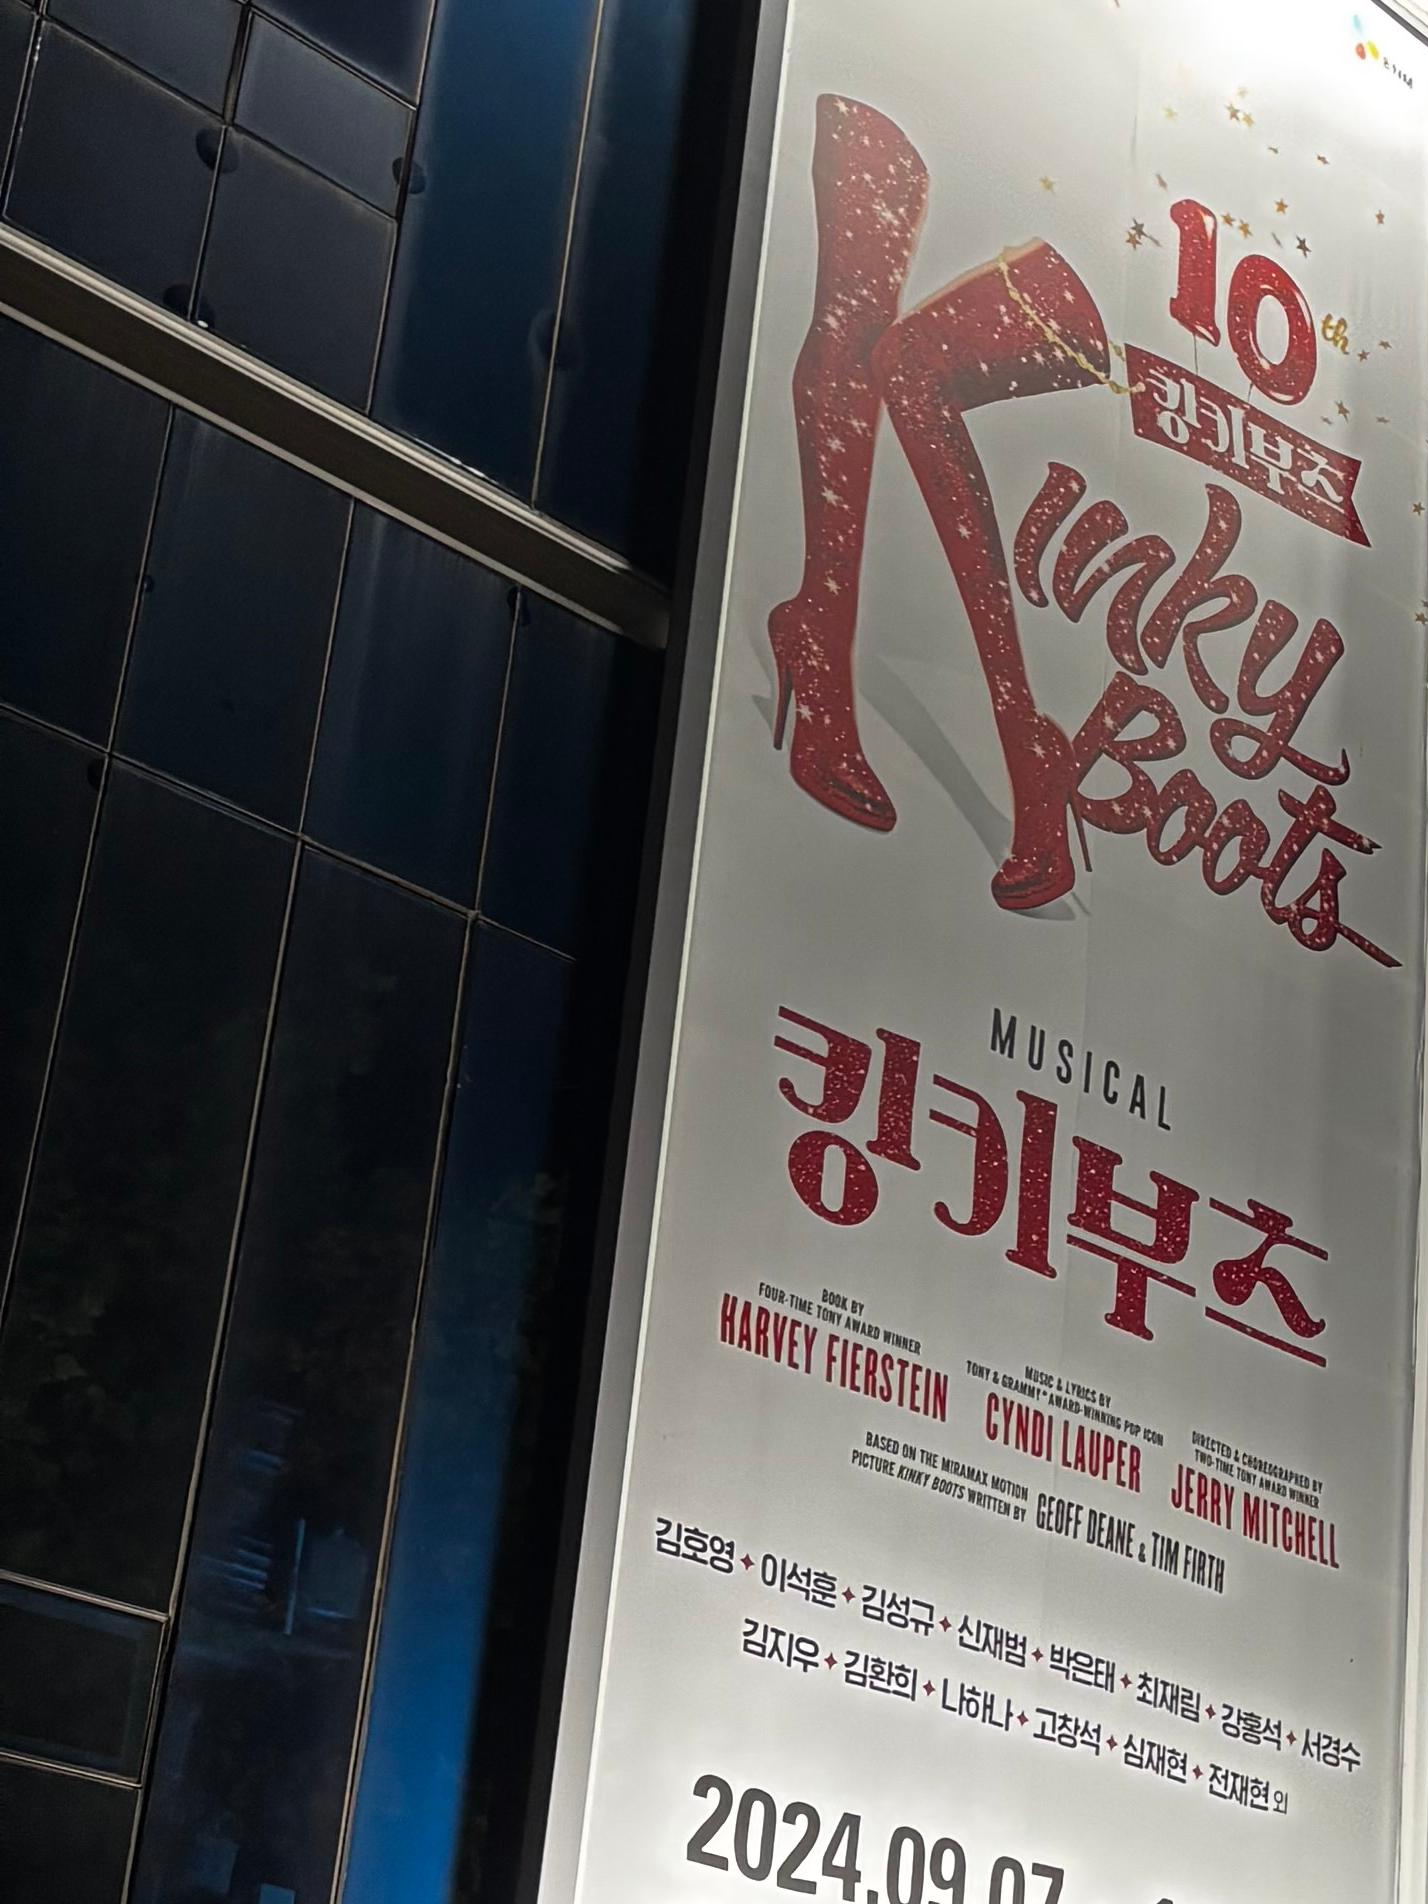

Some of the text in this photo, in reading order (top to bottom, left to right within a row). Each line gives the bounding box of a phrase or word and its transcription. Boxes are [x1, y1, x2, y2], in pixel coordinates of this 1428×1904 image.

[1149, 371, 1346, 512] 킹키부츠
[1071, 671, 1402, 968] Boots
[990, 1008, 1173, 1131] MUSICAL
[774, 1005, 1329, 1368] 킹키부츠
[758, 1281, 922, 1356] FOUR-TIME TONY AWARD WINNER
[821, 1288, 865, 1317] BOOK BY
[720, 1292, 949, 1423] HARVEY FIERSTEIN
[966, 1360, 990, 1379] TONY
[992, 1371, 999, 1384] &
[1124, 1419, 1141, 1438] POP
[1143, 1425, 1164, 1446] ICON
[1024, 1366, 1053, 1389] MUSIC
[1099, 1393, 1112, 1409] BY
[851, 1449, 1027, 1523] PICTURE KINKY BOOTS WRITTEN BY
[865, 1431, 1030, 1503] BASED ON THE MIRAMAX MOTION
[985, 1392, 1142, 1494] CYNDI LAUPER
[1192, 1430, 1323, 1494] DIRECTED & CHOREOGRAPHED BY
[1195, 1449, 1320, 1509] TWO-TIME TONY AWARD WINNER
[1036, 1492, 1226, 1594] GEOFF DEANE & TIM FIRTH
[1171, 1463, 1340, 1569] JERRY MITCHELL
[654, 1517, 1362, 1774] 김호영 이석훈 김성규 신재범 박은태 최재림 강홍석 서경수
[742, 1618, 1289, 1815] 김지우 김환희 나하나 고창석 심재현 전재현 외
